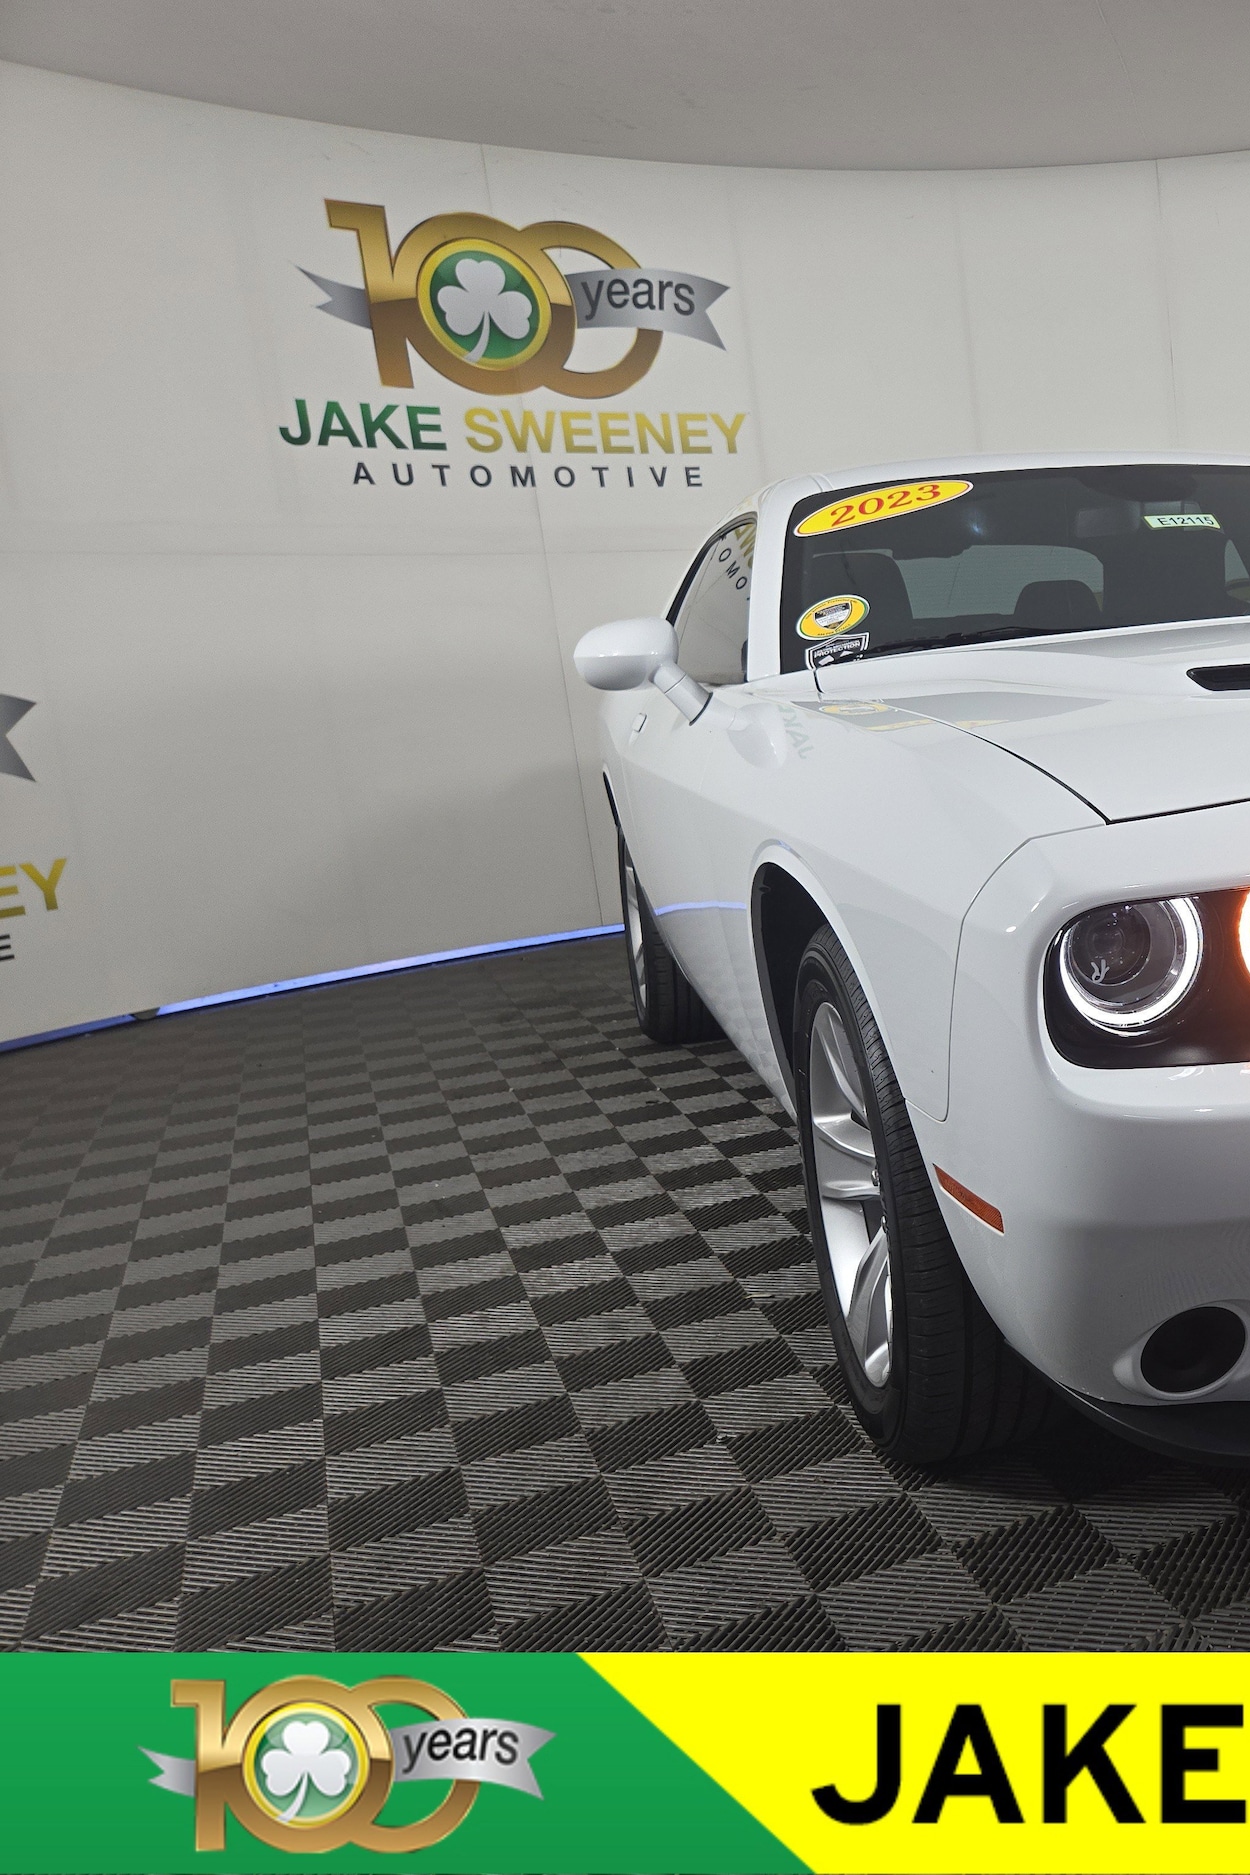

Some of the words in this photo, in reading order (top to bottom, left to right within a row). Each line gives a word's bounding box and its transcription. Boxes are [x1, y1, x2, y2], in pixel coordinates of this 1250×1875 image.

[324, 198, 663, 399] 100
[580, 276, 696, 320] years
[279, 399, 447, 450] JAKE
[464, 409, 746, 454] SWEENEY
[353, 462, 704, 489] AUTOMOTIVE
[830, 484, 942, 527] 2023
[1157, 516, 1215, 525] E12115
